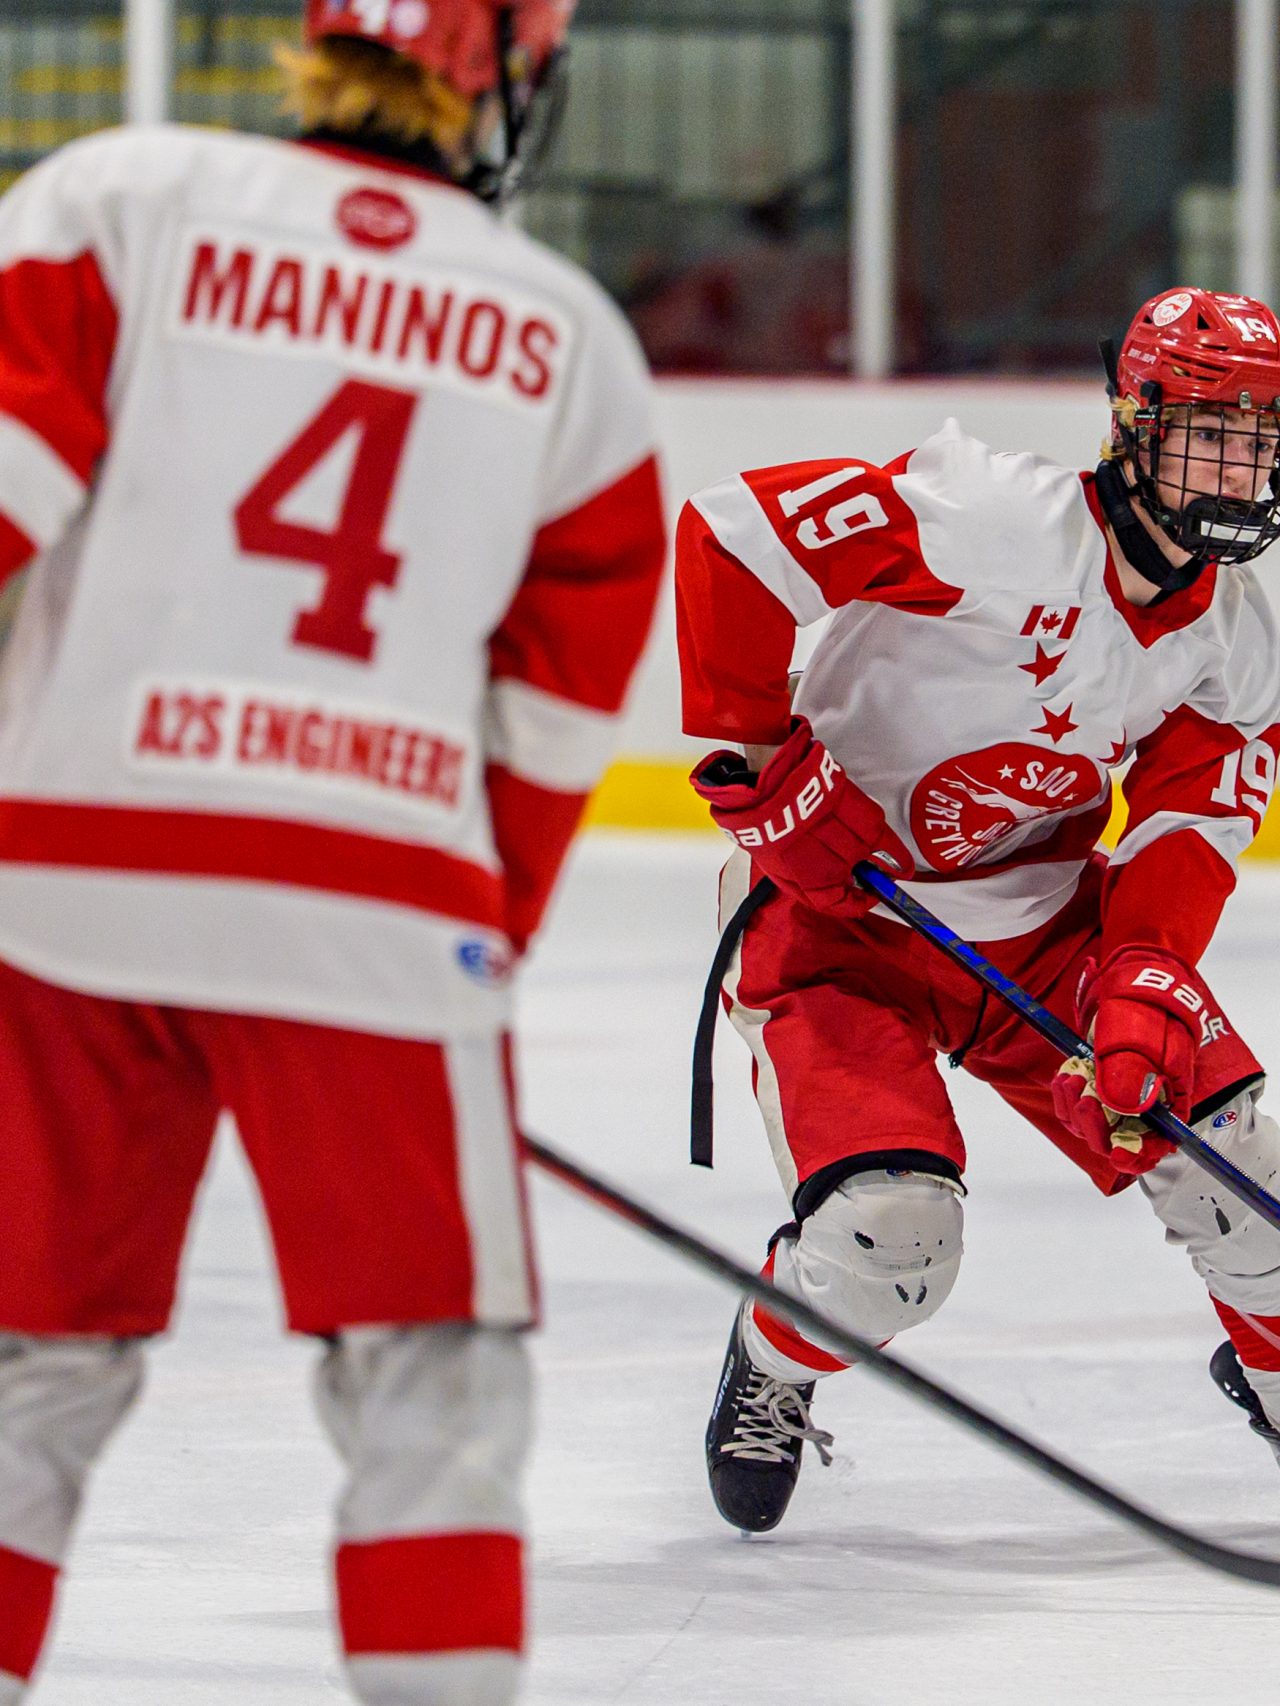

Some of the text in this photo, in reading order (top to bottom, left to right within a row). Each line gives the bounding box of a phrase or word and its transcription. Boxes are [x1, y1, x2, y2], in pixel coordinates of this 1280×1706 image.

[184, 241, 558, 398] MANINOS
[1227, 316, 1277, 343] 19
[234, 376, 421, 663] 4
[777, 466, 889, 549] 19
[135, 692, 465, 808] A2S ENGINEERS
[1019, 761, 1078, 798] SOO
[1210, 739, 1276, 824] 19
